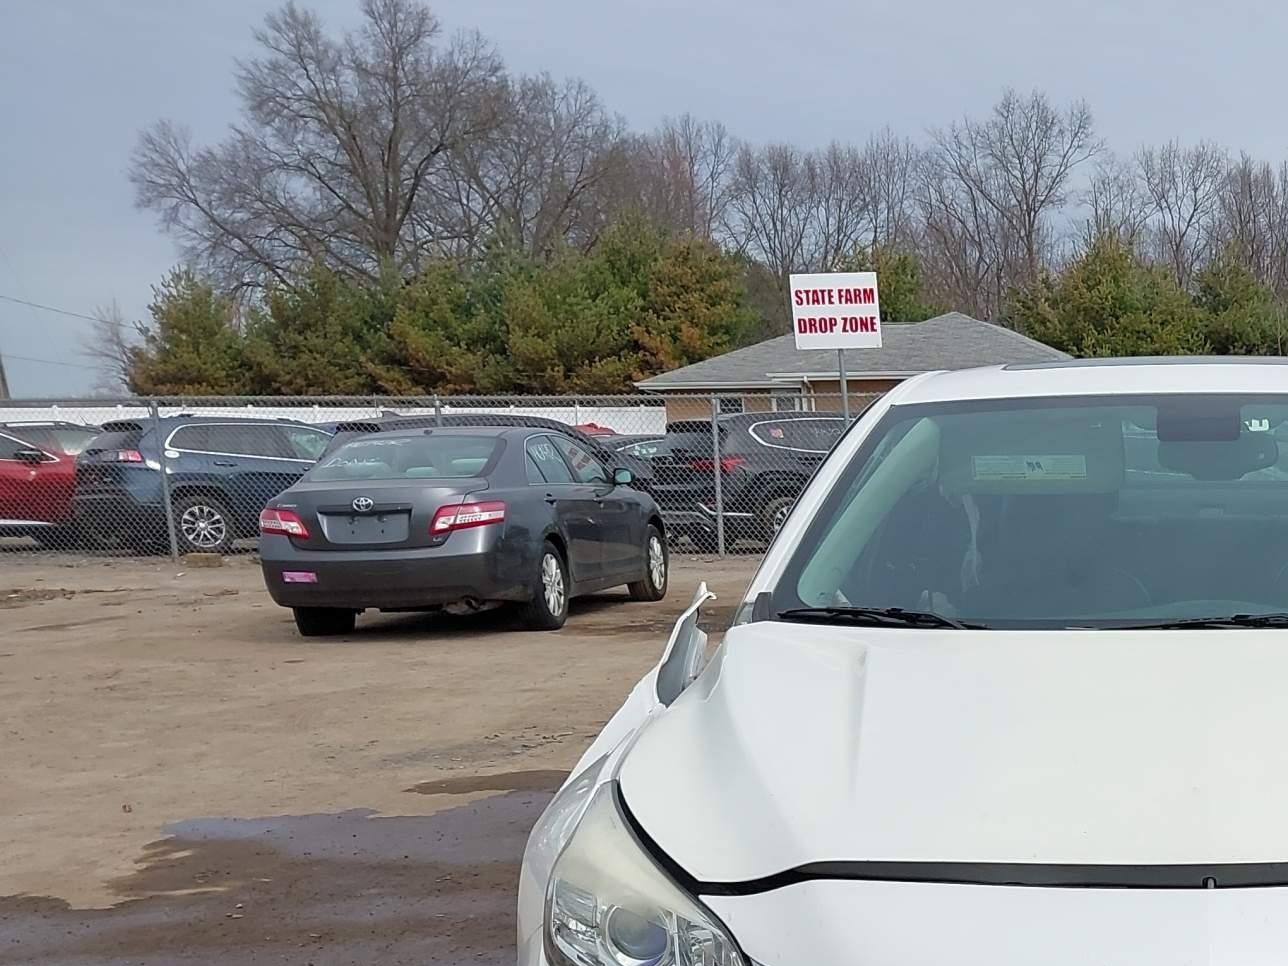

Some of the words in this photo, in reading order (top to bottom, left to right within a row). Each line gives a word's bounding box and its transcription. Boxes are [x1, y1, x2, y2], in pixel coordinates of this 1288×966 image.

[794, 289, 835, 305] STATE
[838, 287, 875, 304] FARM
[797, 317, 838, 334] DROP
[840, 316, 878, 333] ZONE
